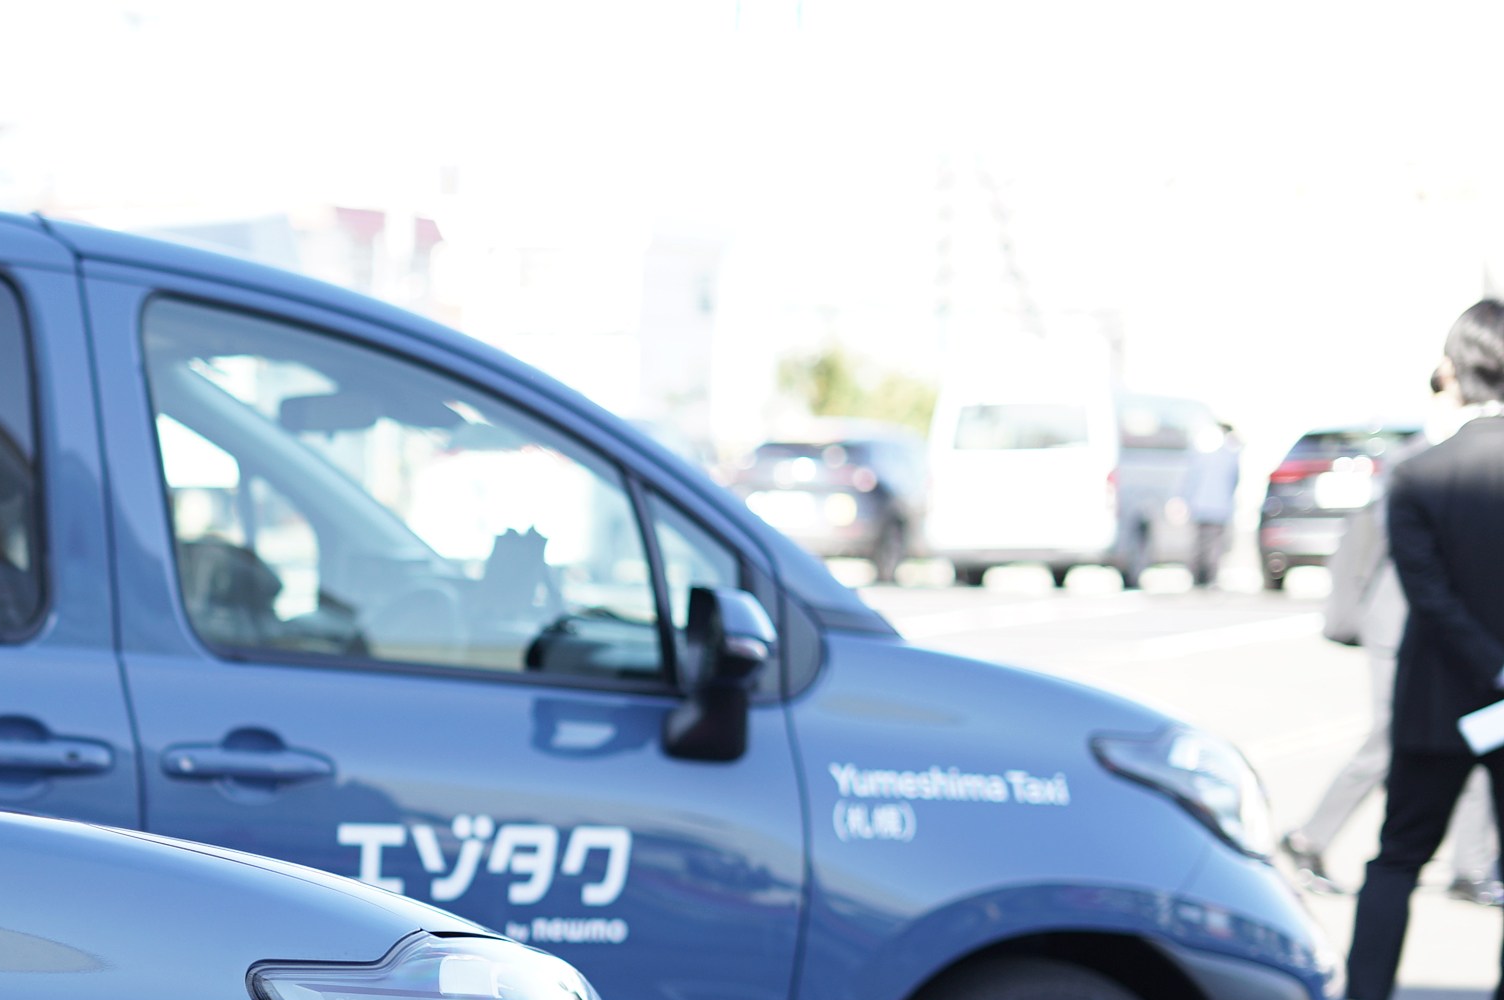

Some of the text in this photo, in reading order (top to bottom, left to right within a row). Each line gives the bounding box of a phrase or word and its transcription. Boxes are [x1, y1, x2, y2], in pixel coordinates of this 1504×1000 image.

[828, 762, 1070, 806] Yumeshima Taxi
[337, 814, 632, 906] エゾタク
[532, 917, 628, 944] newmo
